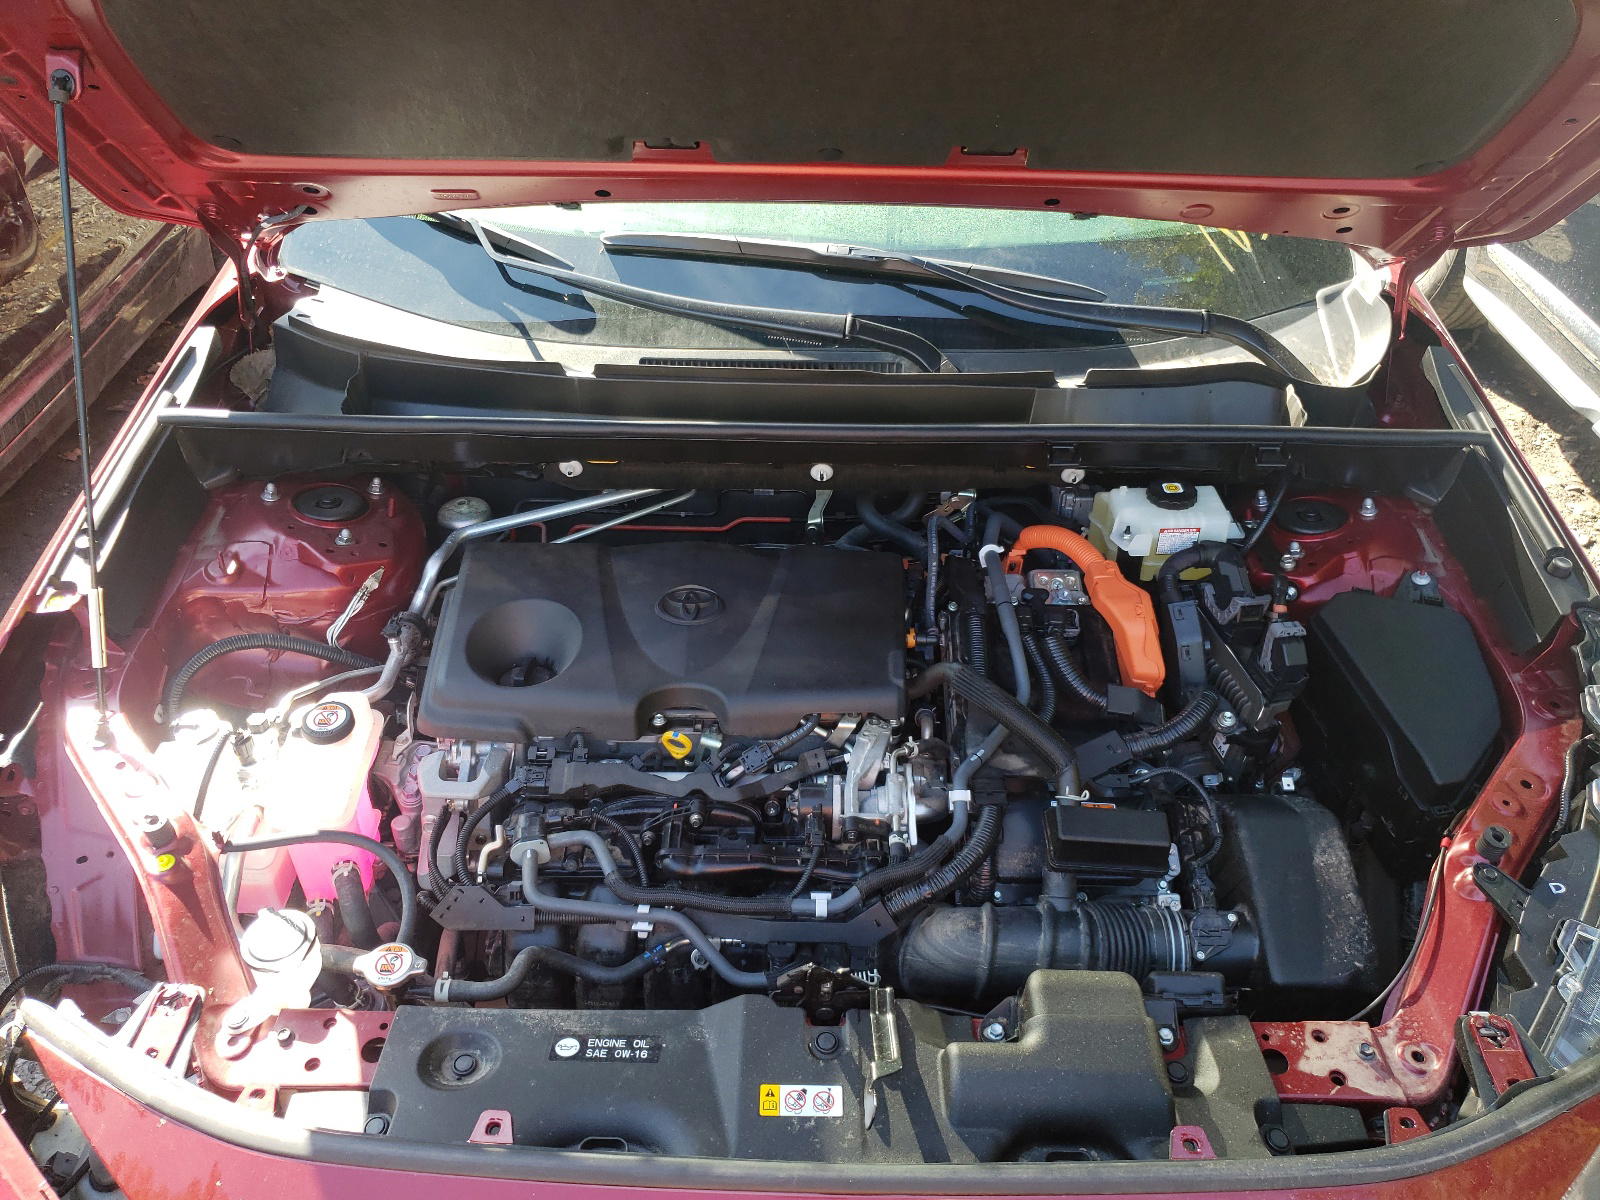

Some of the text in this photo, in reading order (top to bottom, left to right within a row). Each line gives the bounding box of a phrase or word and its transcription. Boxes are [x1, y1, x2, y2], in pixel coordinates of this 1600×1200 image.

[587, 1038, 650, 1048] ENGINE OIL
[585, 1049, 648, 1058] SAE 0W-16
